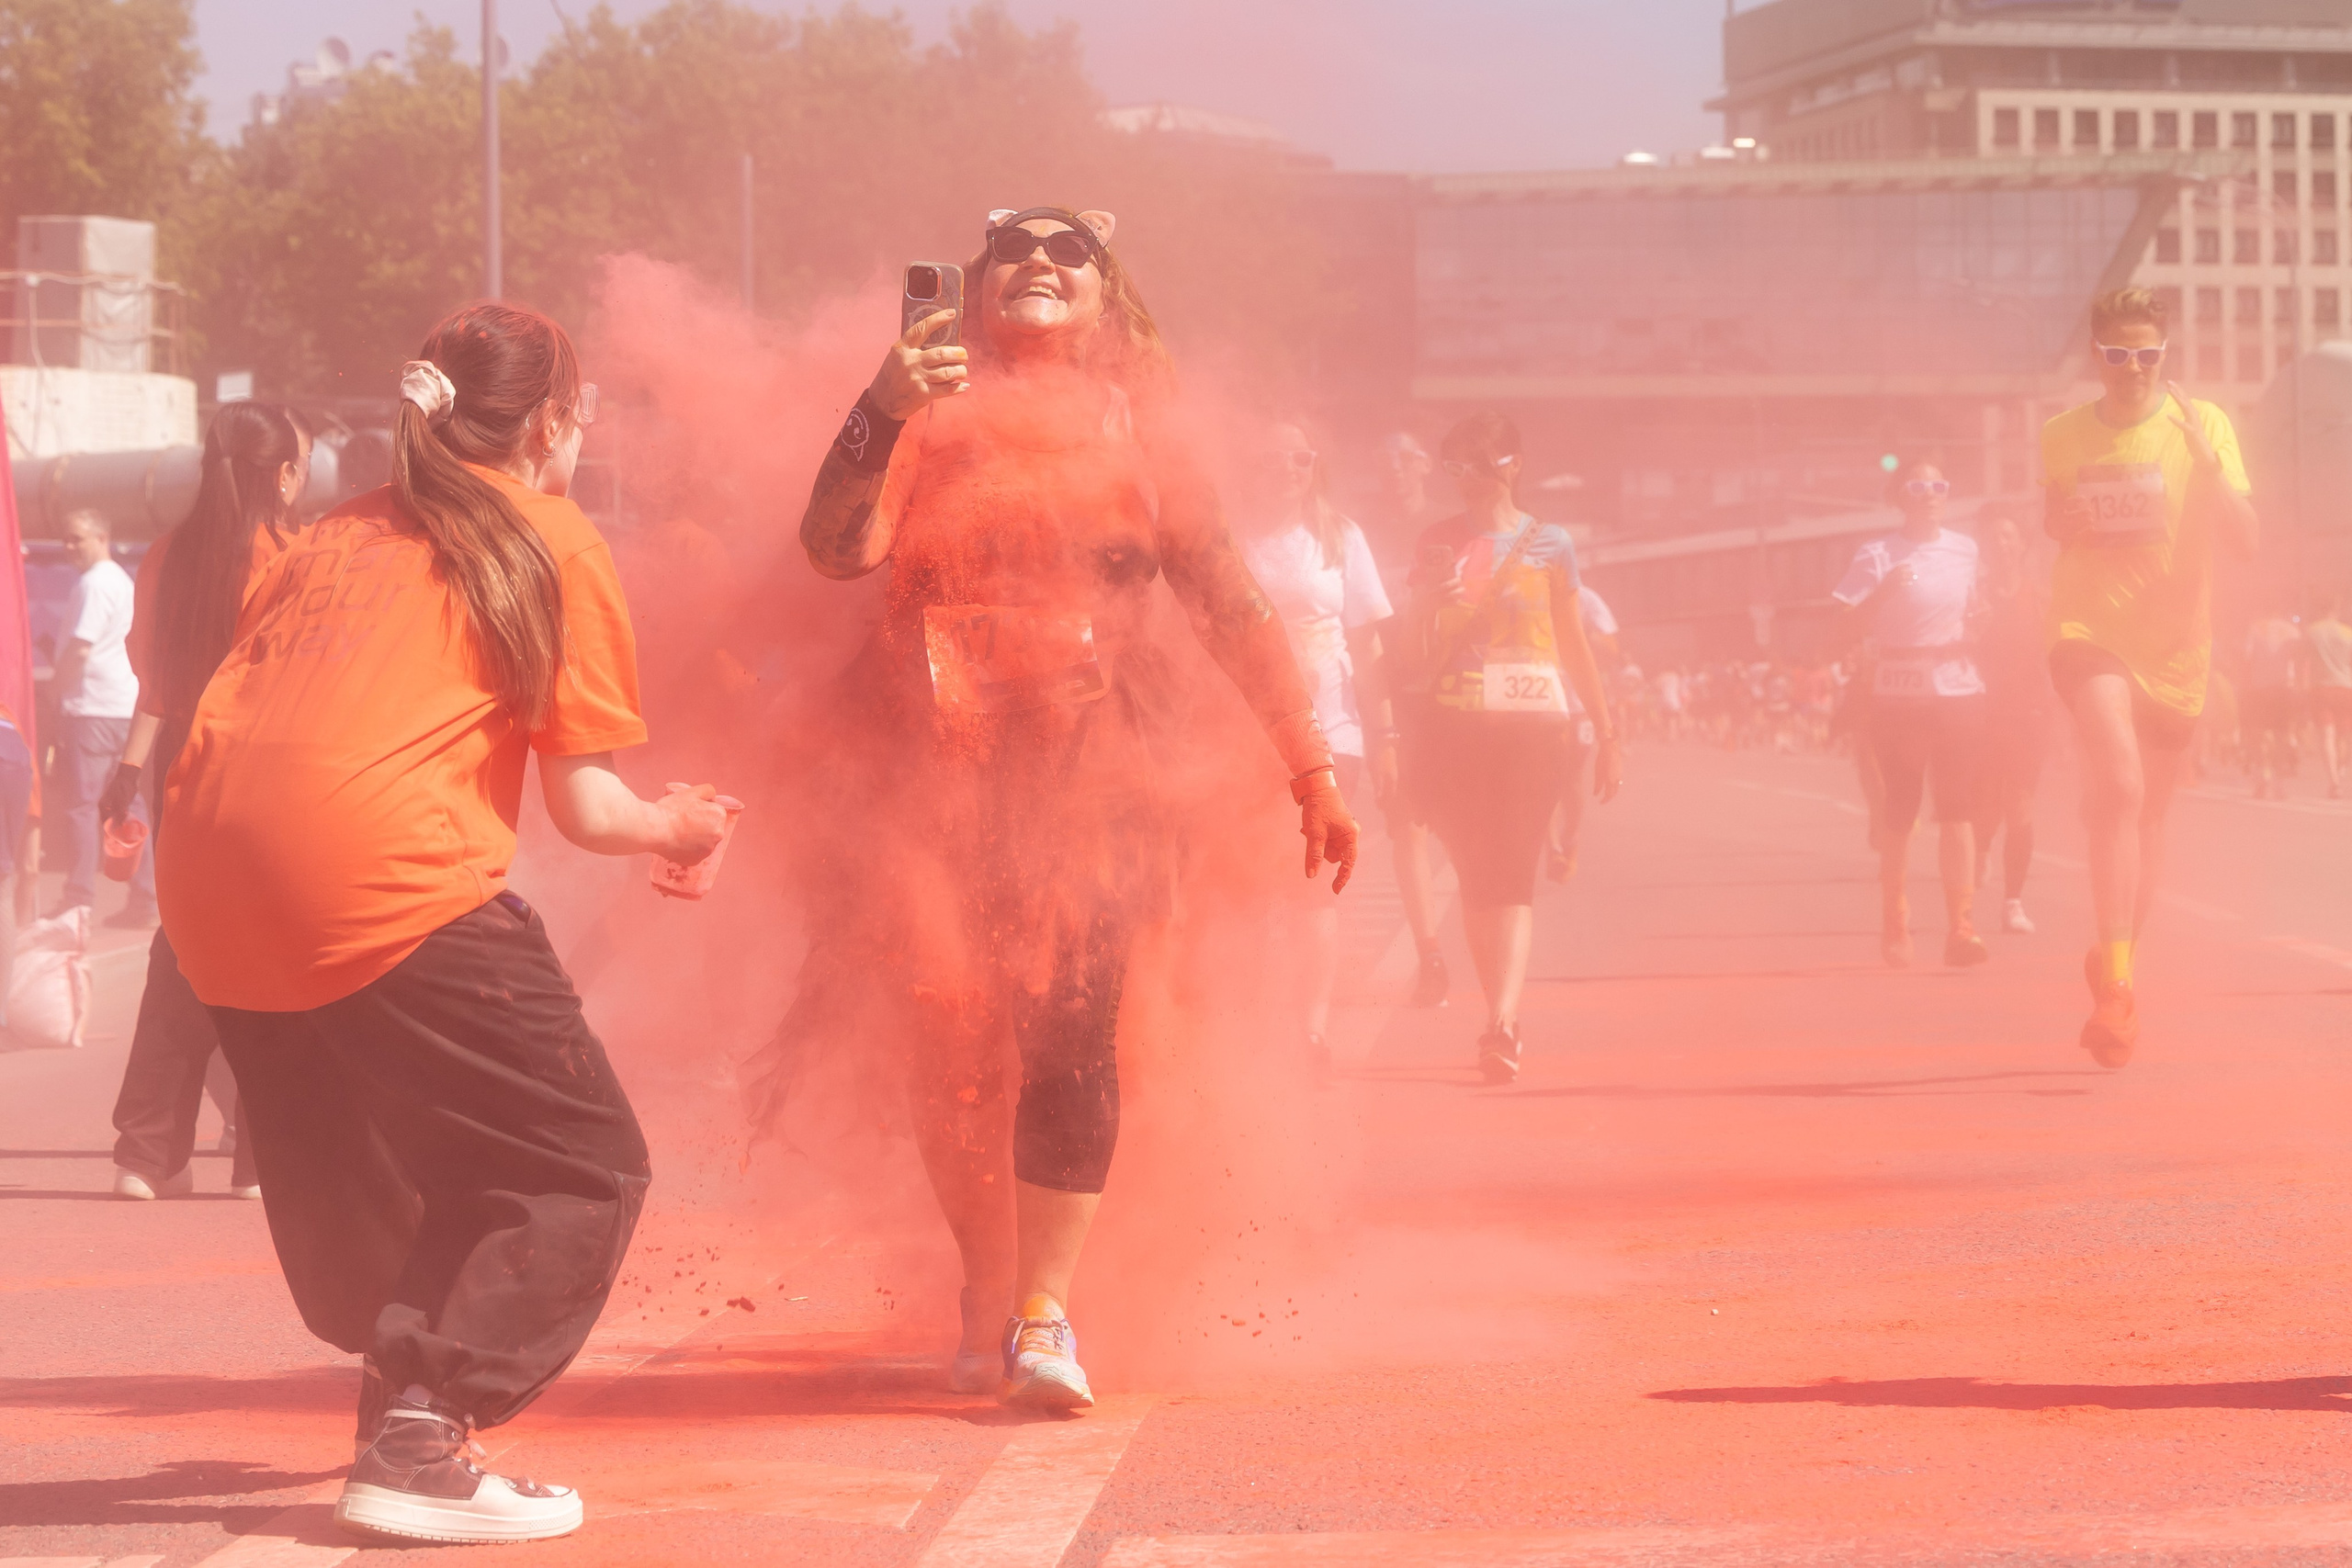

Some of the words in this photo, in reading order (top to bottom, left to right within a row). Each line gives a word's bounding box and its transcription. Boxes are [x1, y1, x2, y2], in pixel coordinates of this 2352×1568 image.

[2090, 491, 2150, 521] 1362
[252, 624, 376, 663] way
[1504, 675, 1550, 700] 322
